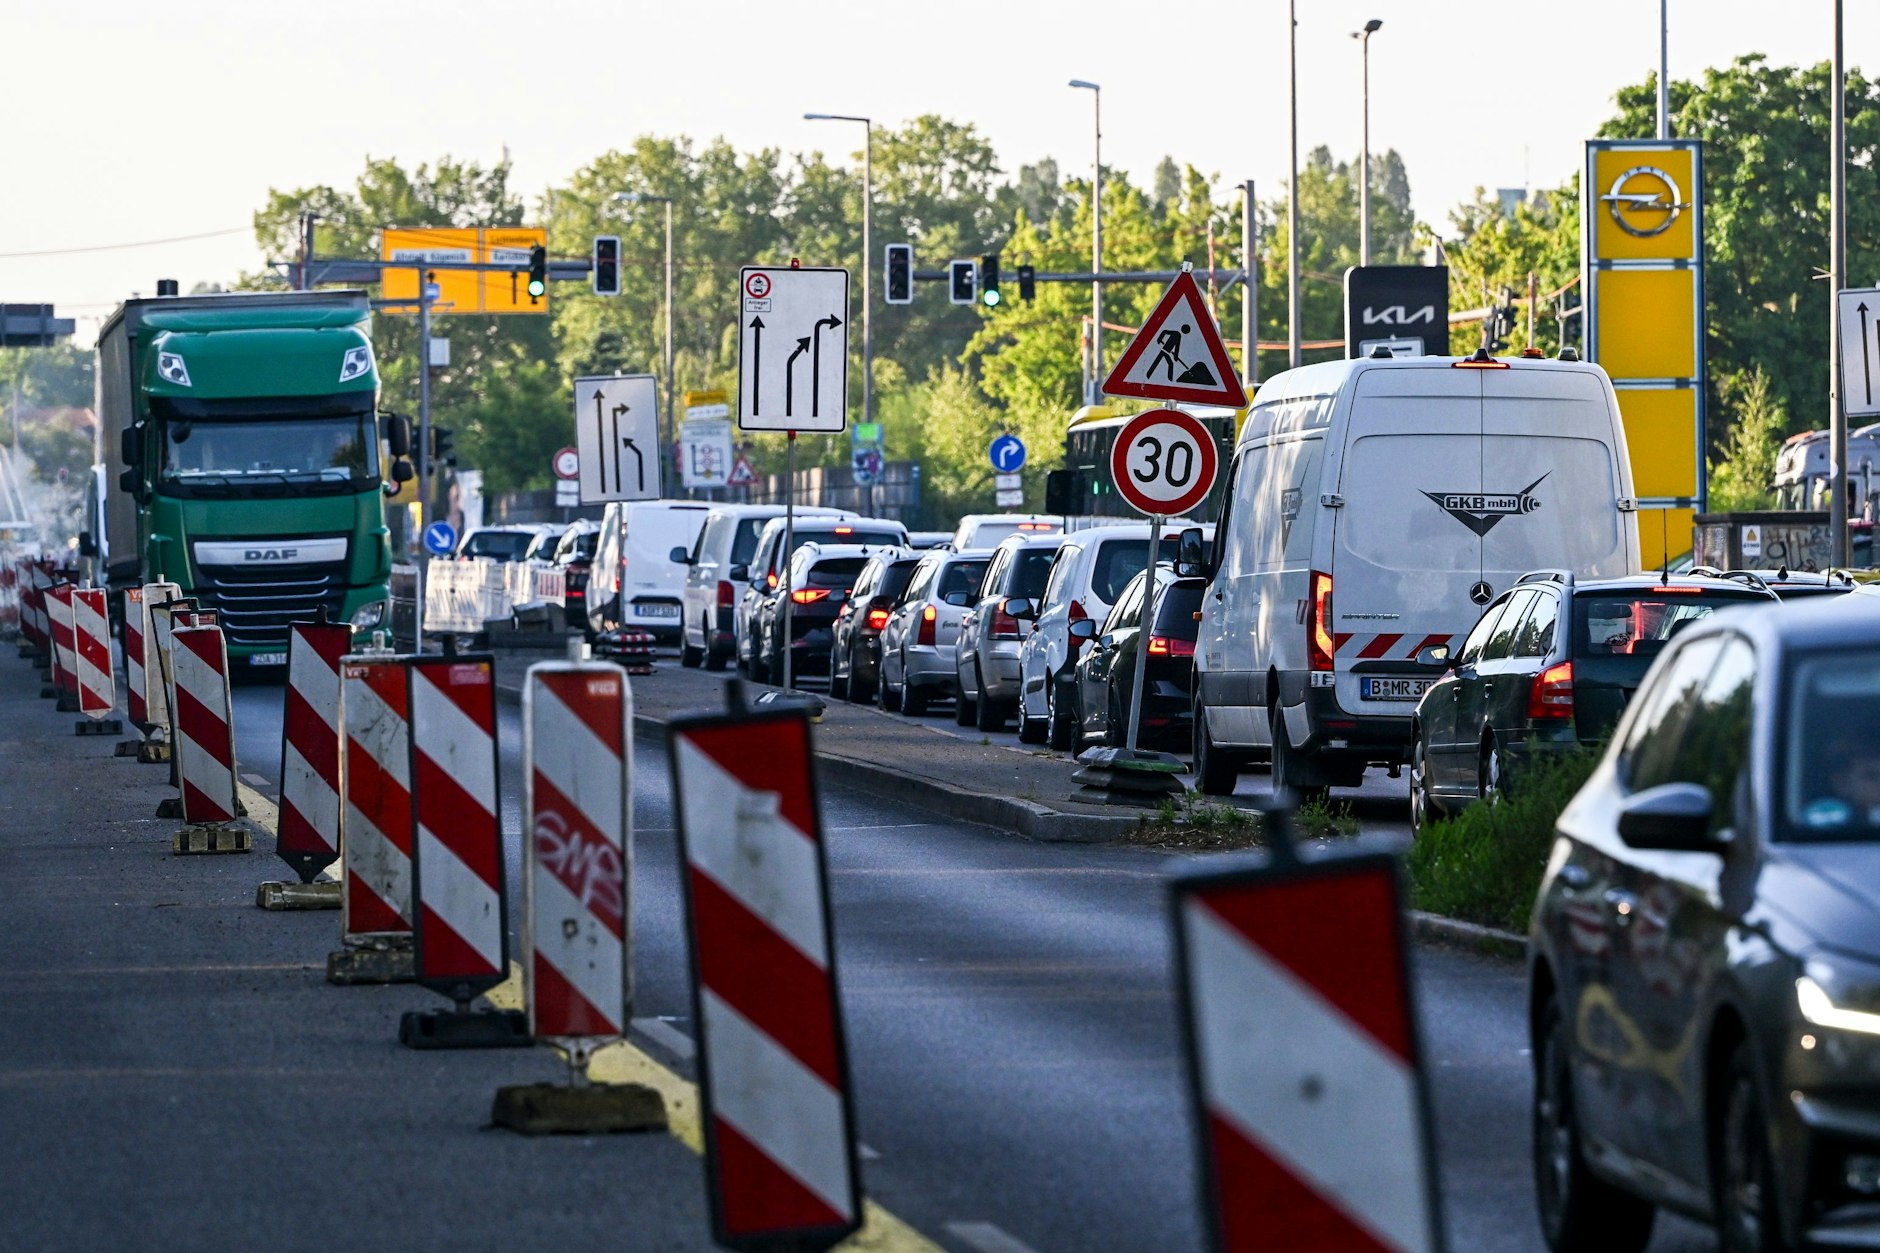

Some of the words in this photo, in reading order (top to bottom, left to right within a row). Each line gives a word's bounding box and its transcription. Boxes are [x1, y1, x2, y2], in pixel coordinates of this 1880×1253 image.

[1363, 305, 1435, 324] KIA
[1133, 436, 1193, 487] 30
[1445, 496, 1485, 509] GKB
[1487, 499, 1516, 508] mbH
[244, 549, 298, 560] DAF
[1371, 681, 1381, 695] B
[1391, 681, 1410, 695] MR
